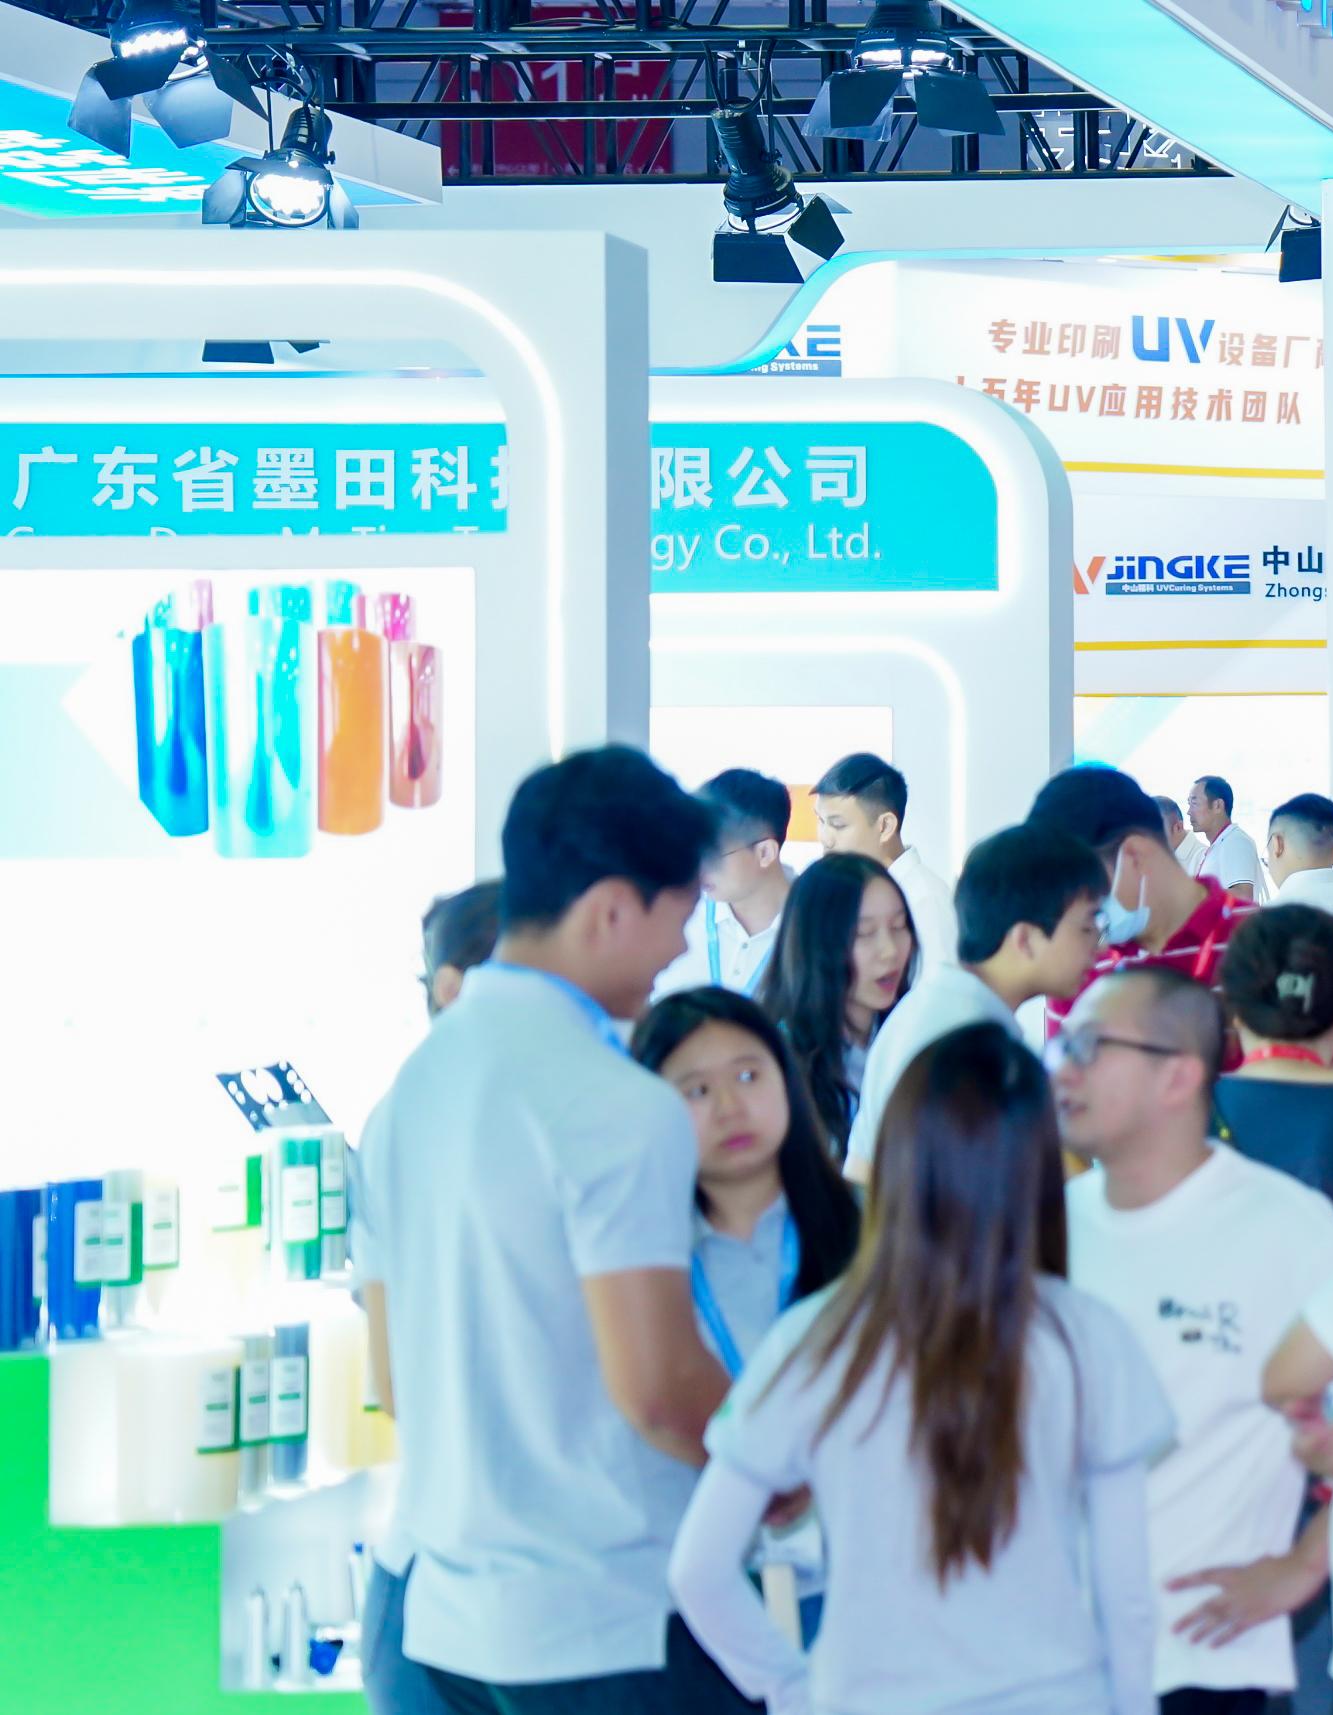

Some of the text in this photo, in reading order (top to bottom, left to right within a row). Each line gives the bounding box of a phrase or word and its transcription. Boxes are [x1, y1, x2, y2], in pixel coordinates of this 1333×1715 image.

[956, 376, 1302, 425] 五年UV应用技术团队
[714, 523, 790, 565] Co.,
[807, 521, 882, 560] Ltd.
[1198, 583, 1234, 593] Systems
